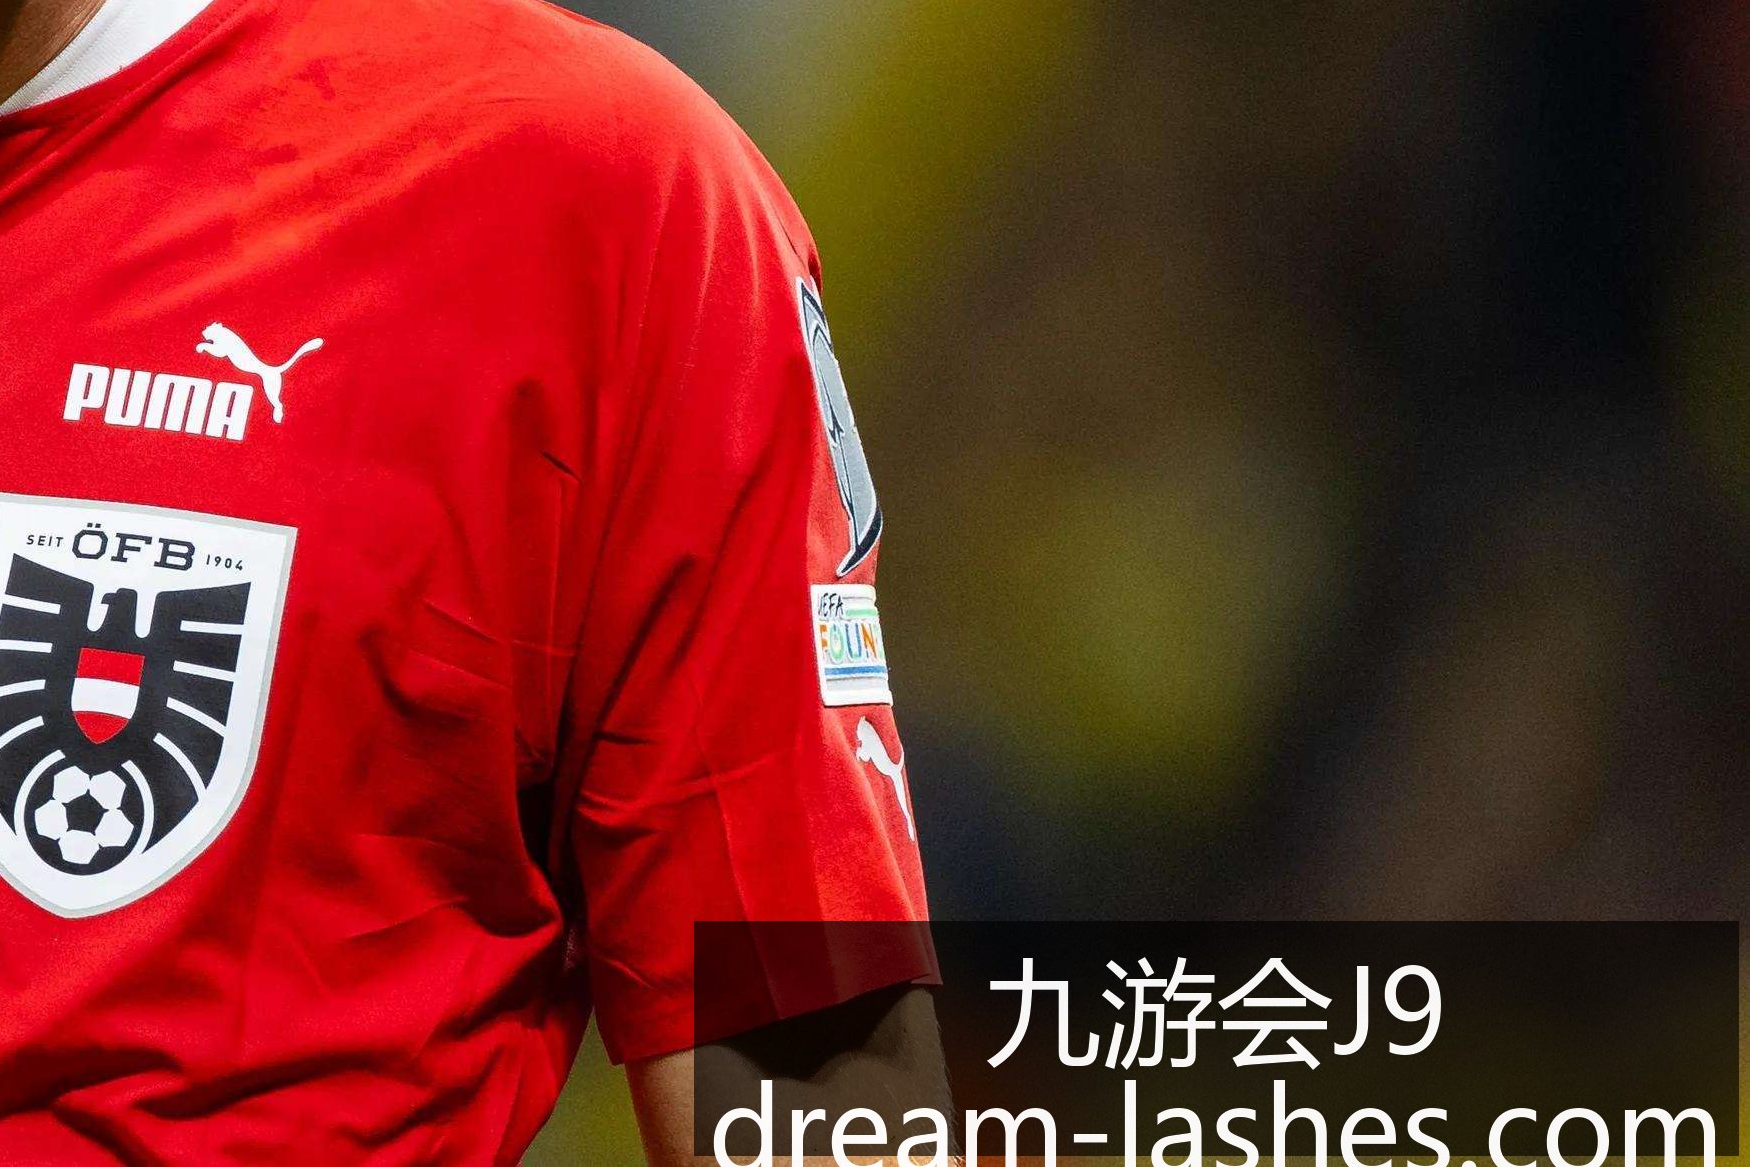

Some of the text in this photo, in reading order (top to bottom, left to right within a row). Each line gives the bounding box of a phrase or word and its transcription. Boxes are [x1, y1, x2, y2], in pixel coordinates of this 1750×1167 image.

[63, 363, 254, 441] PUMA
[26, 522, 244, 572] SEIT ÖFB 1904
